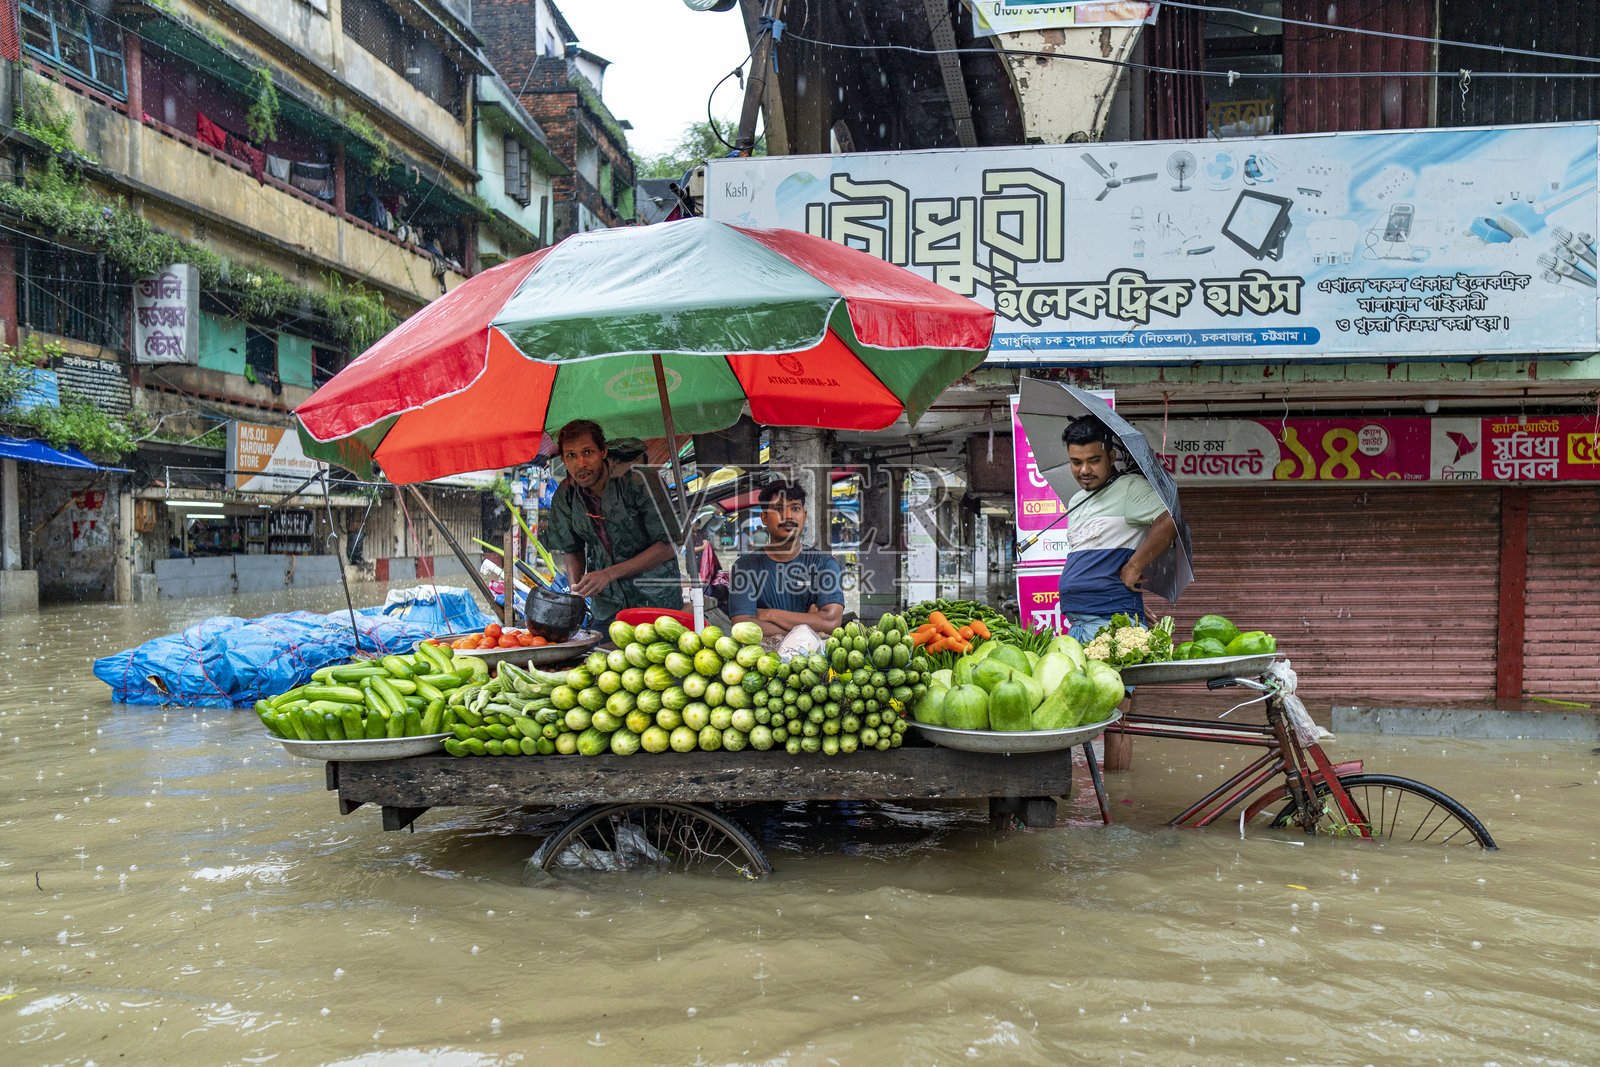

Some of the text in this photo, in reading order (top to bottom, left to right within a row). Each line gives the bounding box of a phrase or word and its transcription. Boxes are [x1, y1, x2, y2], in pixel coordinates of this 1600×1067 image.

[725, 182, 748, 198] Kash
[806, 168, 1064, 298] চৌধুরী
[139, 272, 182, 299] অলি
[1318, 271, 1531, 294] এখানে সকল প্রকার ইলেকট্রিক
[994, 267, 1305, 327] ইলেকট্রিক হাউস
[1357, 291, 1488, 312] মালামাল পাইকারী
[1336, 318, 1350, 332] ও
[1393, 313, 1439, 332] বিক্রয়
[1440, 315, 1473, 331] করা
[998, 334, 1041, 348] আধুনিক
[1045, 336, 1063, 346] চক
[1066, 335, 1097, 347] সুপার
[1100, 332, 1135, 345] মার্কেট
[240, 426, 267, 441] M/S.OLI
[1492, 423, 1519, 434] ক্যাশ
[240, 441, 274, 455] HARDWARE
[1174, 439, 1226, 452] খরচ কম
[1492, 431, 1559, 461] সুবিধা
[240, 454, 259, 468] STORE
[1181, 449, 1264, 475] এজেন্টে
[1492, 459, 1559, 479] ডাবল
